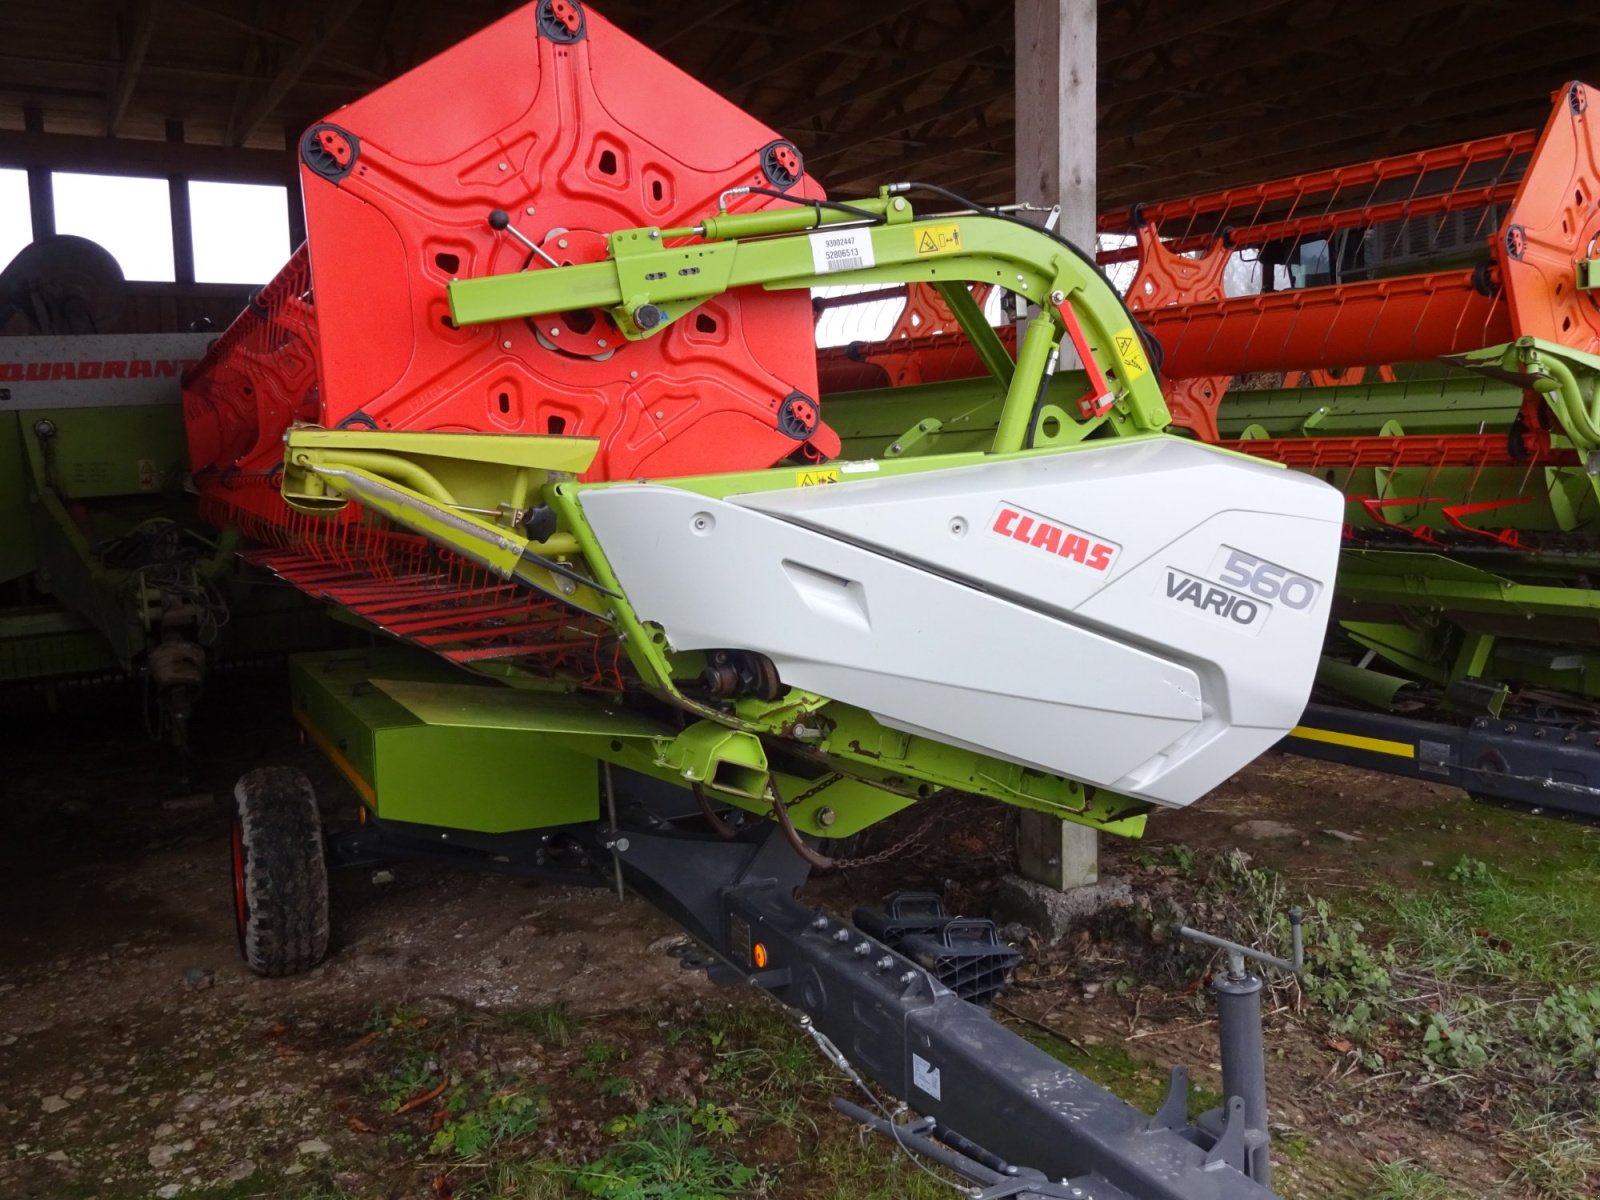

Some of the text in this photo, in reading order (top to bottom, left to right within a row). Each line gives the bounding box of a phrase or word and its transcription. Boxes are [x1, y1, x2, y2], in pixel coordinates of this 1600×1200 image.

[825, 248, 859, 260] 52806513
[992, 508, 1114, 572] CLAAS
[1167, 571, 1258, 626] VARIO
[1219, 550, 1315, 611] 560
